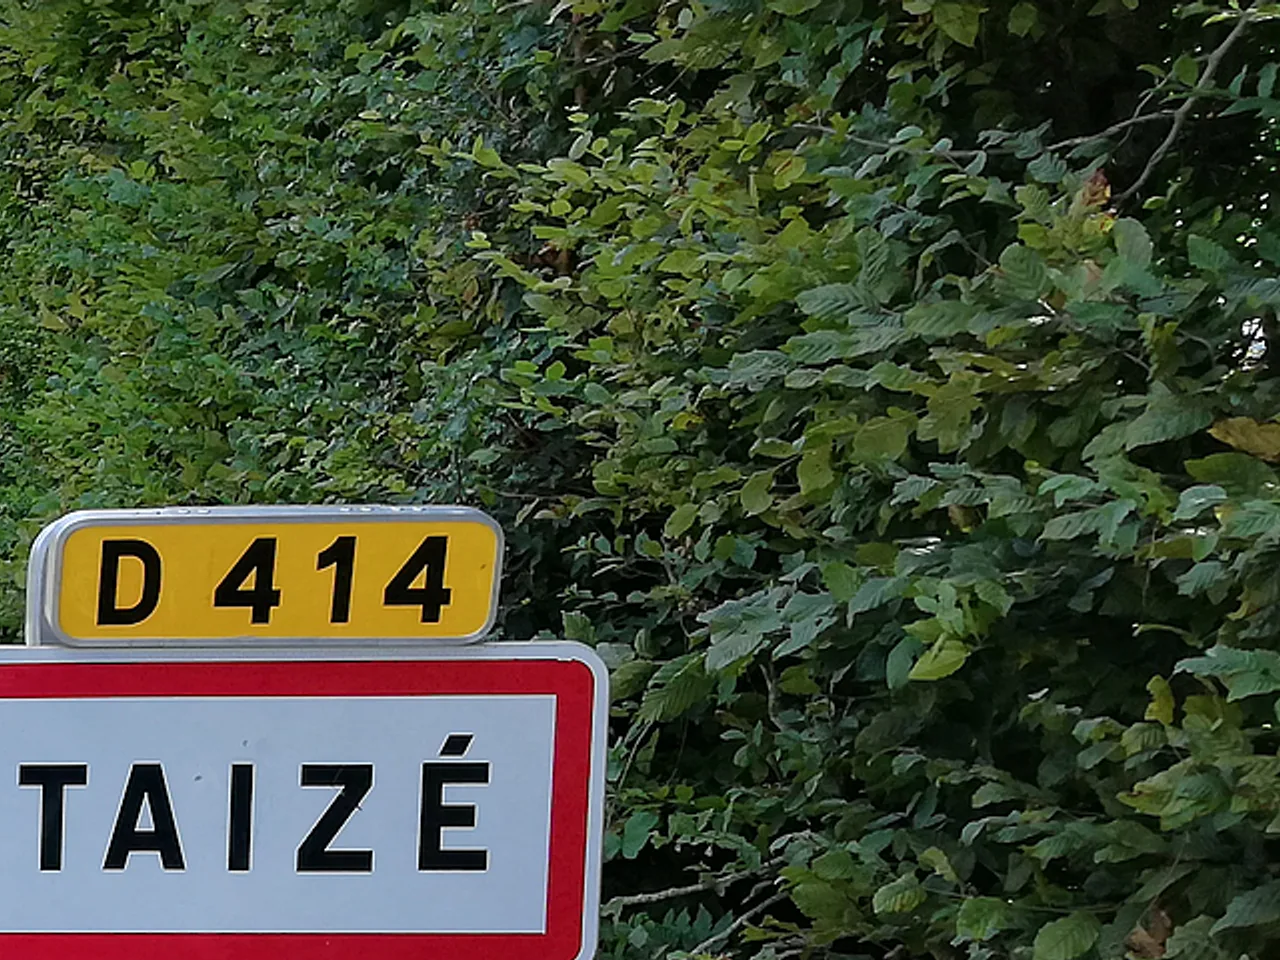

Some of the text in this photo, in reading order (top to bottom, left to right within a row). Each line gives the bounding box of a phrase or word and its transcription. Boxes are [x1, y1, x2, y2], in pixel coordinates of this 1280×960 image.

[96, 535, 451, 626] D 414
[18, 734, 491, 873] TAIZÉ
